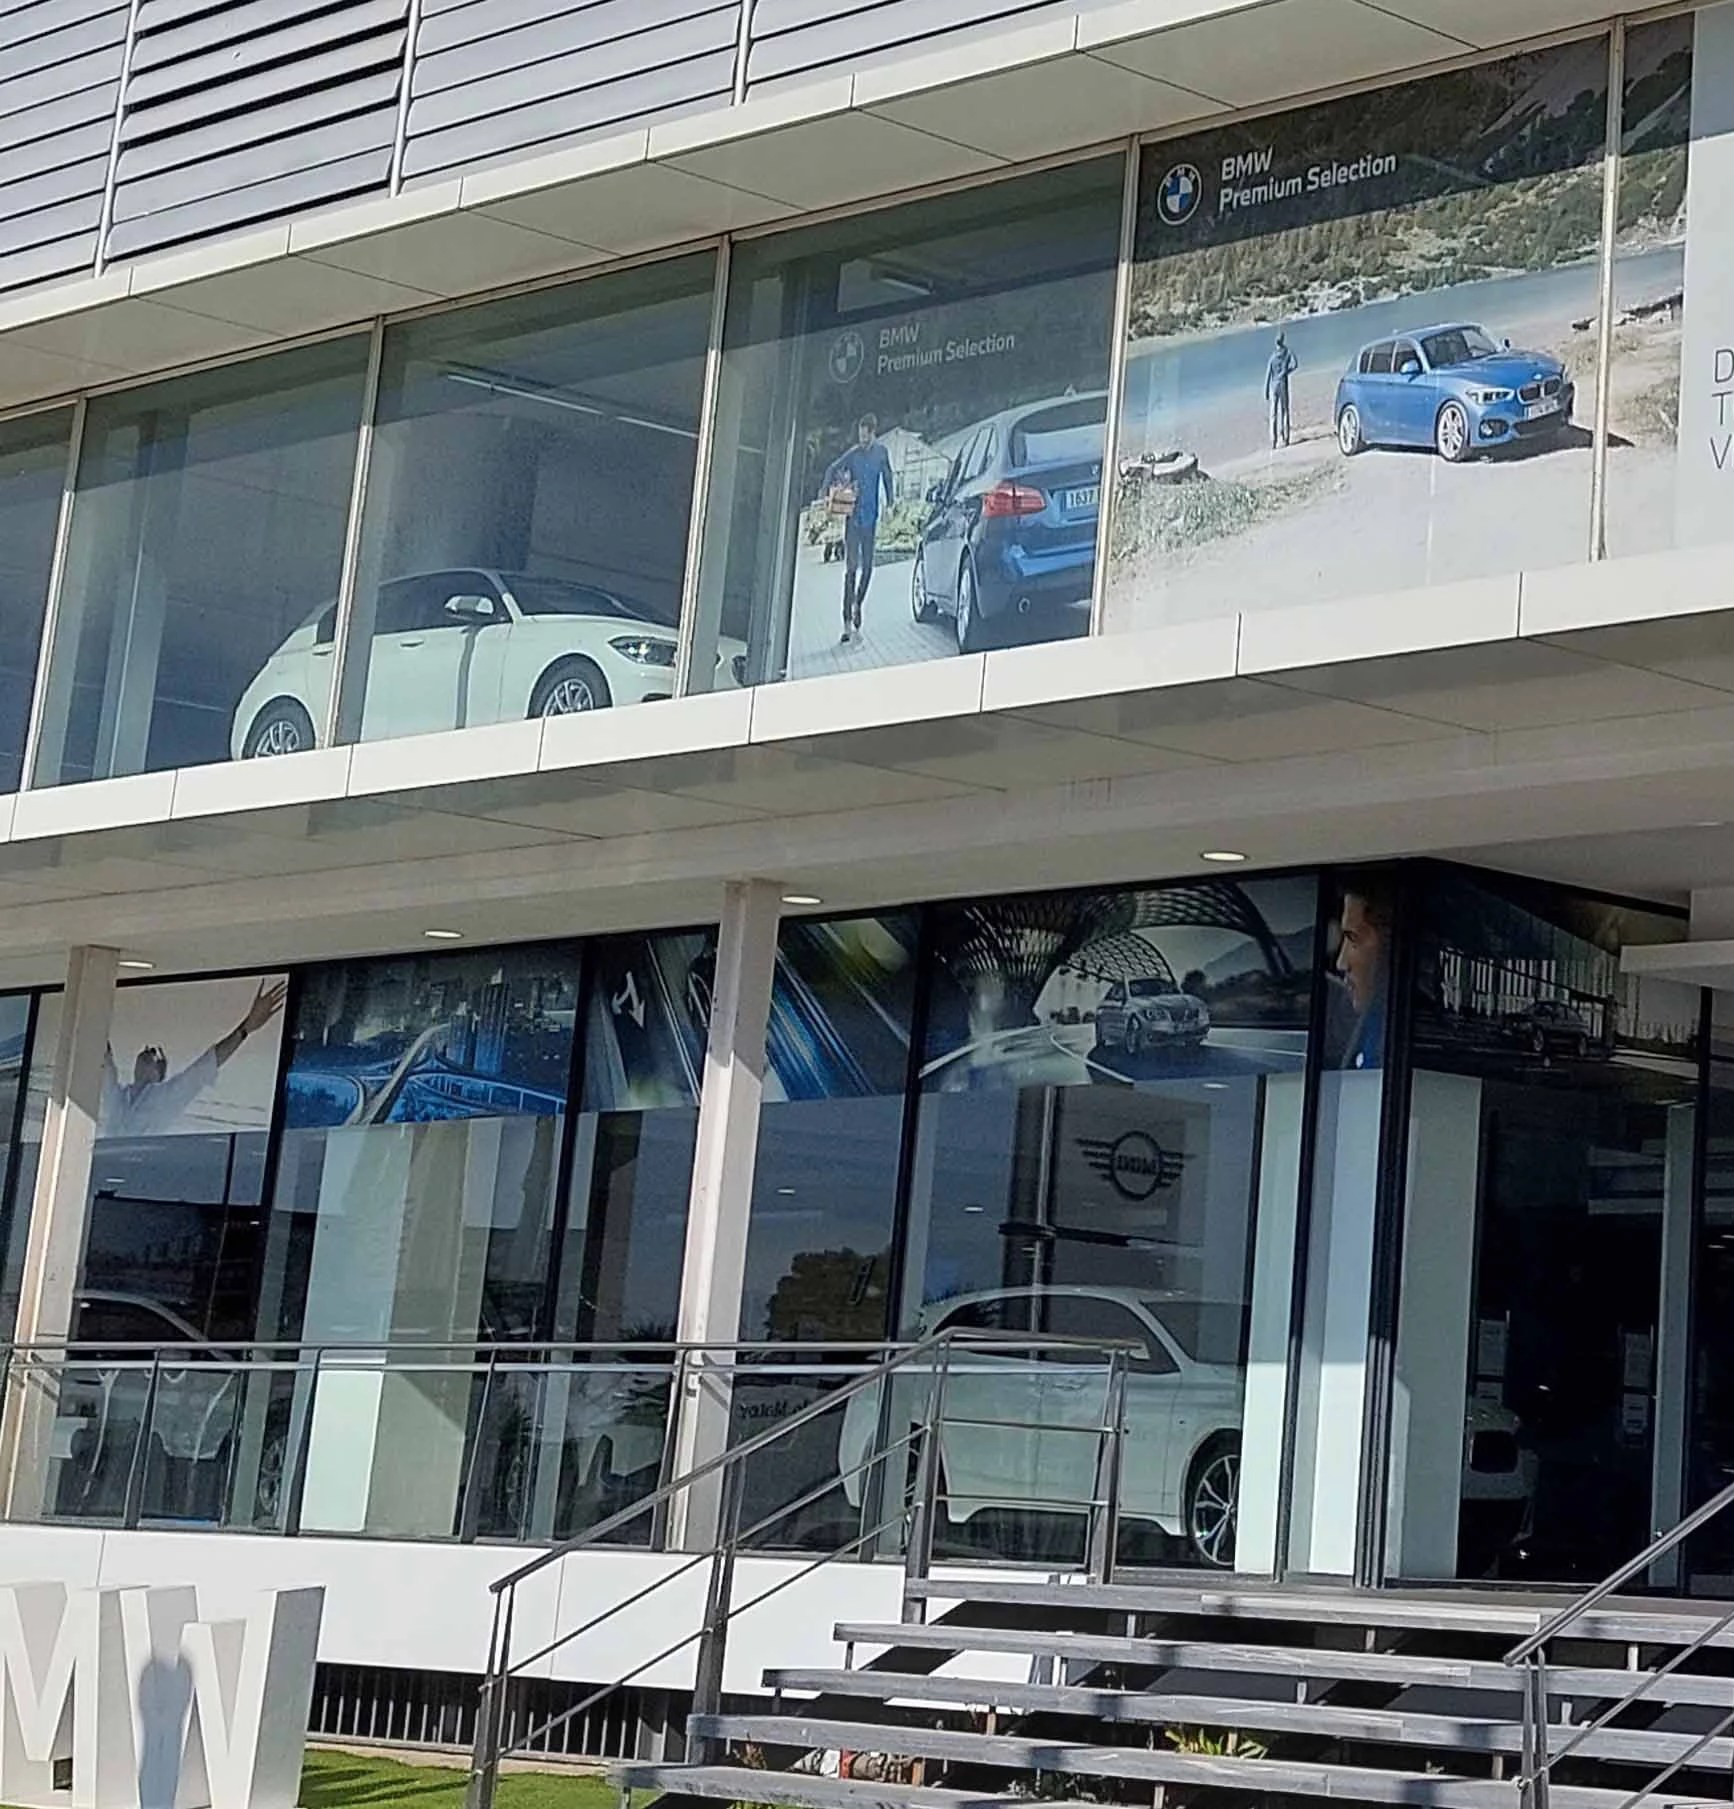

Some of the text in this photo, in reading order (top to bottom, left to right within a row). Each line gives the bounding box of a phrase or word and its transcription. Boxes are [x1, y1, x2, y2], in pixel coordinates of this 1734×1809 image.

[1221, 145, 1273, 181] BMW
[1219, 153, 1397, 213] Premium Selection
[877, 333, 1015, 375] Premium Selection
[879, 322, 920, 348] BMW
